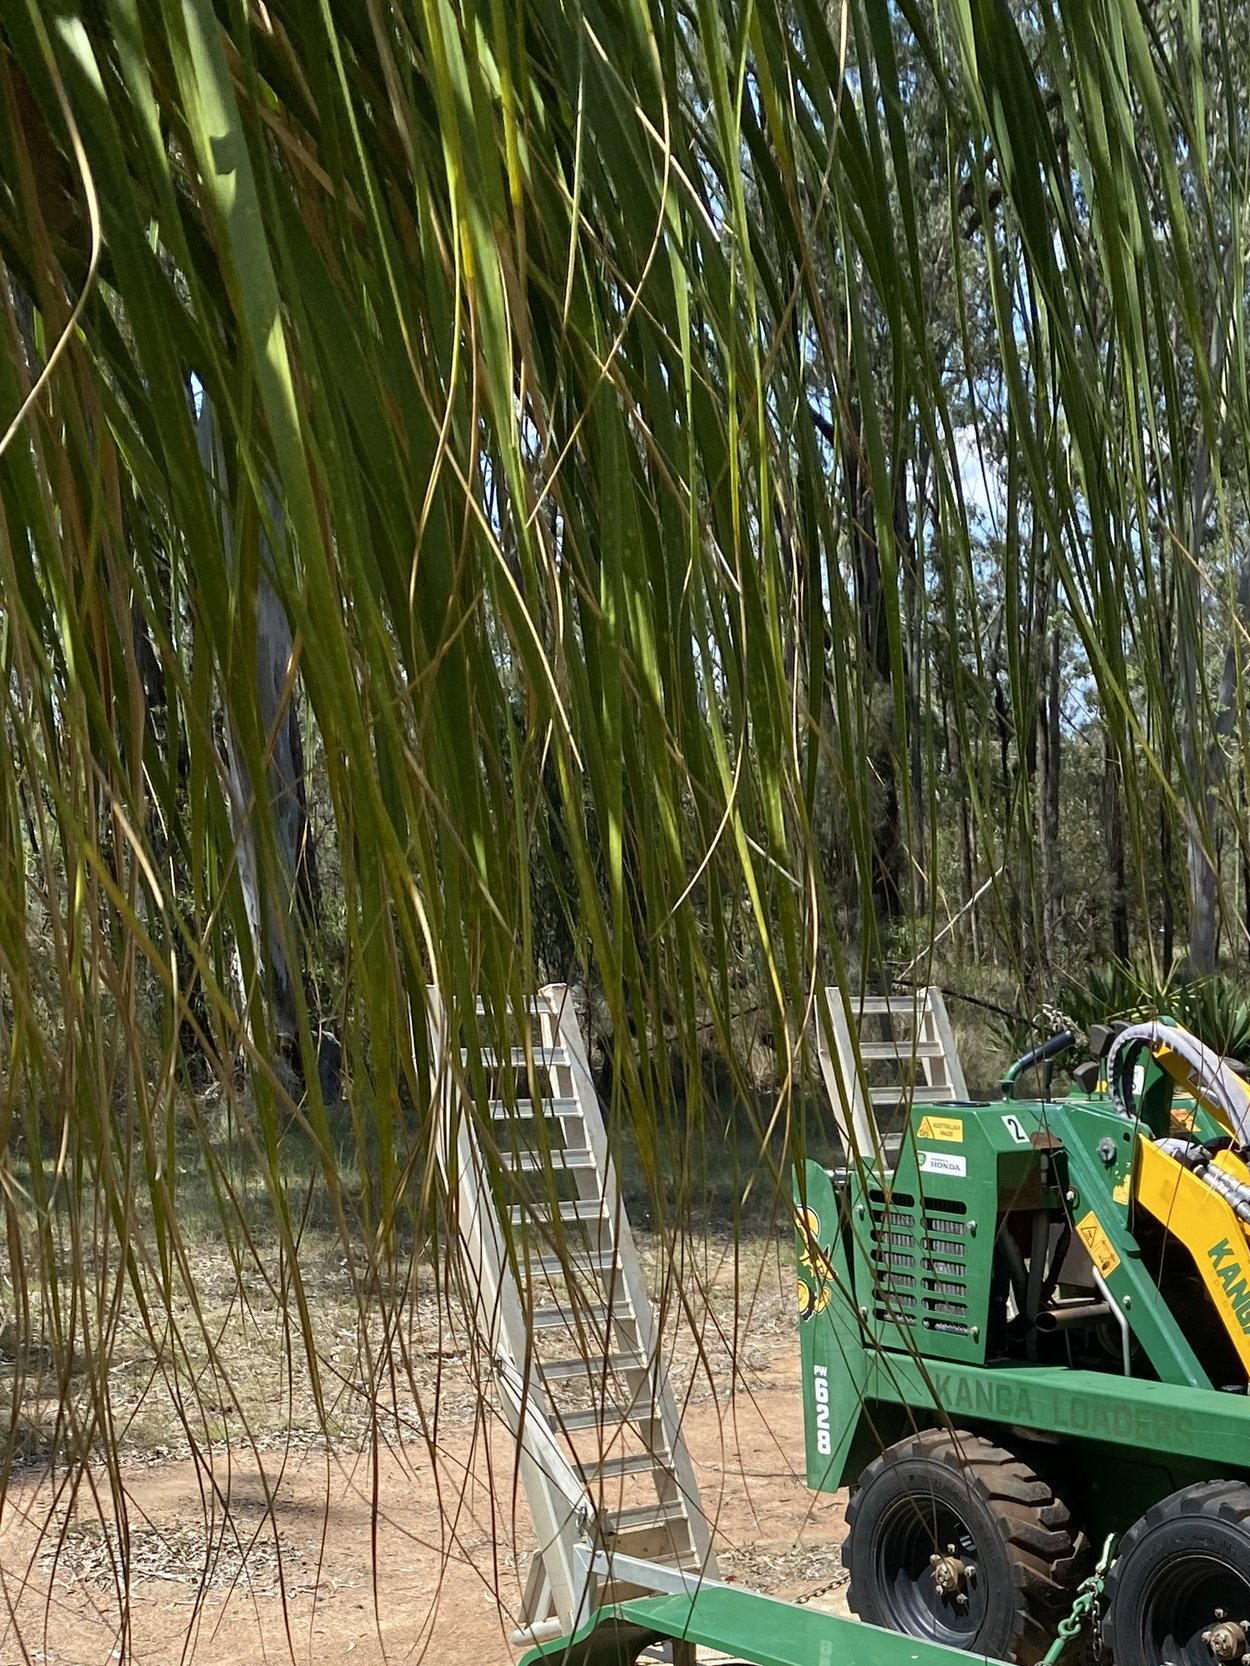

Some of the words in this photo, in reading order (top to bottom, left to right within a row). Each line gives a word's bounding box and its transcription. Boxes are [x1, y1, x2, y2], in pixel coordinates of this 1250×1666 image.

[1007, 1118, 1026, 1140] 2
[930, 1161, 961, 1172] HONDA
[813, 1364, 828, 1377] PW
[814, 1377, 832, 1455] 628
[935, 1372, 1035, 1421] KANGA
[1053, 1397, 1194, 1447] LOADERS
